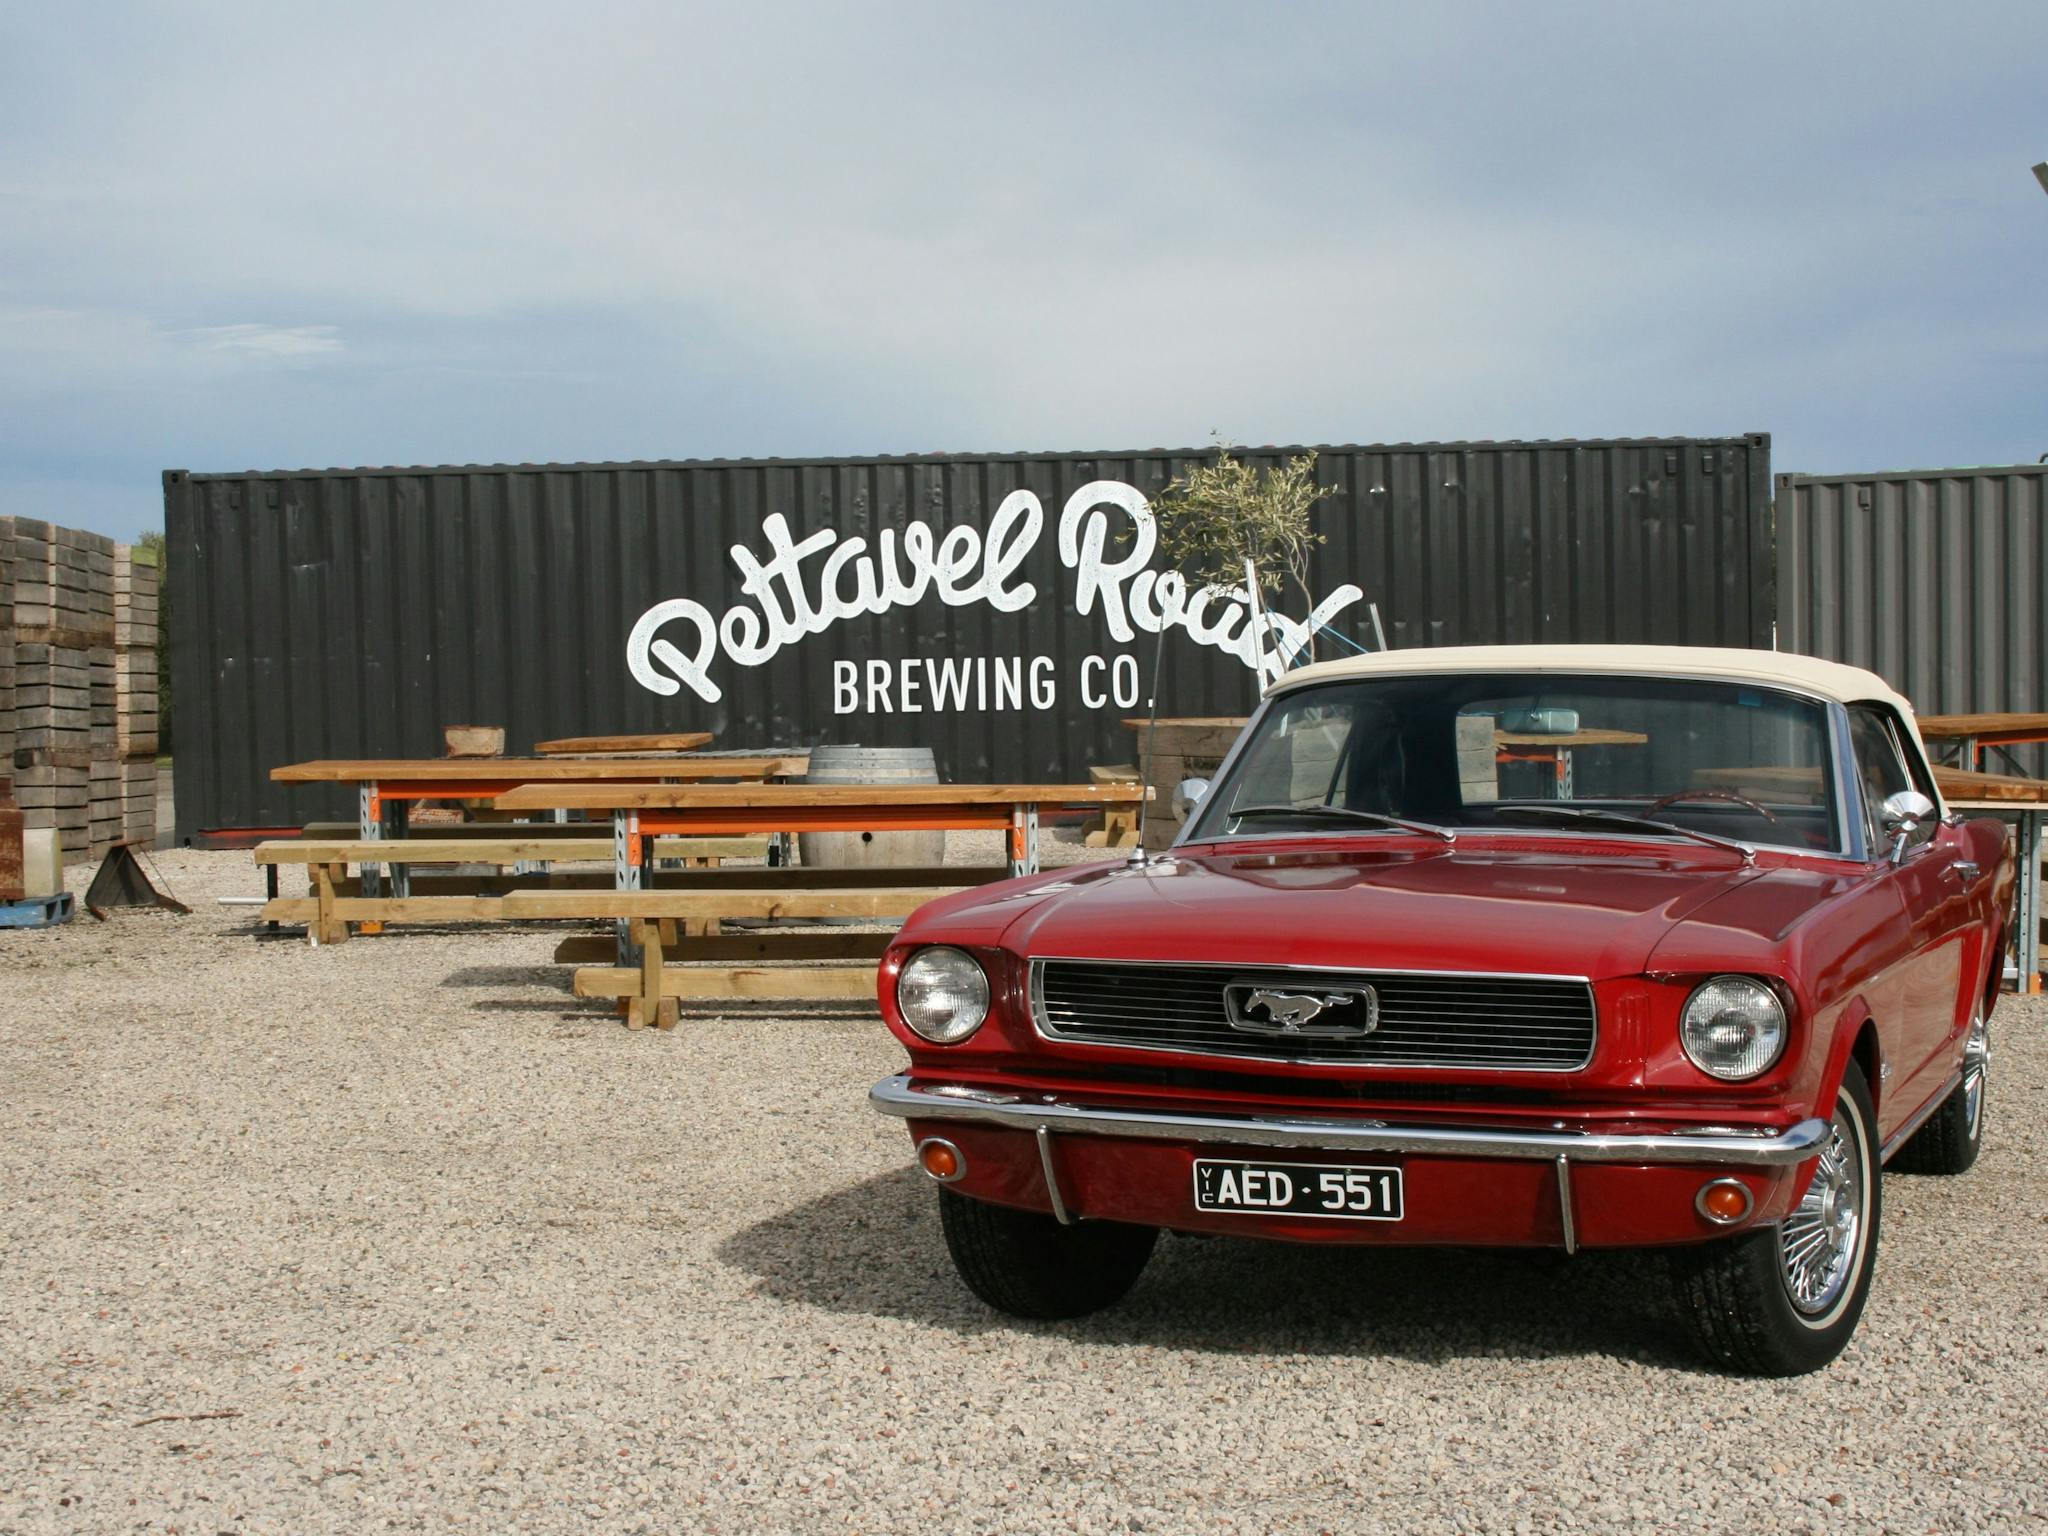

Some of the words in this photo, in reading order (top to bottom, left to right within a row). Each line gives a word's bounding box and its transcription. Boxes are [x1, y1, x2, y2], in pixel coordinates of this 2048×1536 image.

[627, 489, 1043, 703] Pettavel
[1058, 480, 1363, 682] Road
[834, 656, 1055, 714] BREWING
[1080, 654, 1153, 709] CO.
[1201, 1168, 1214, 1203] VIC
